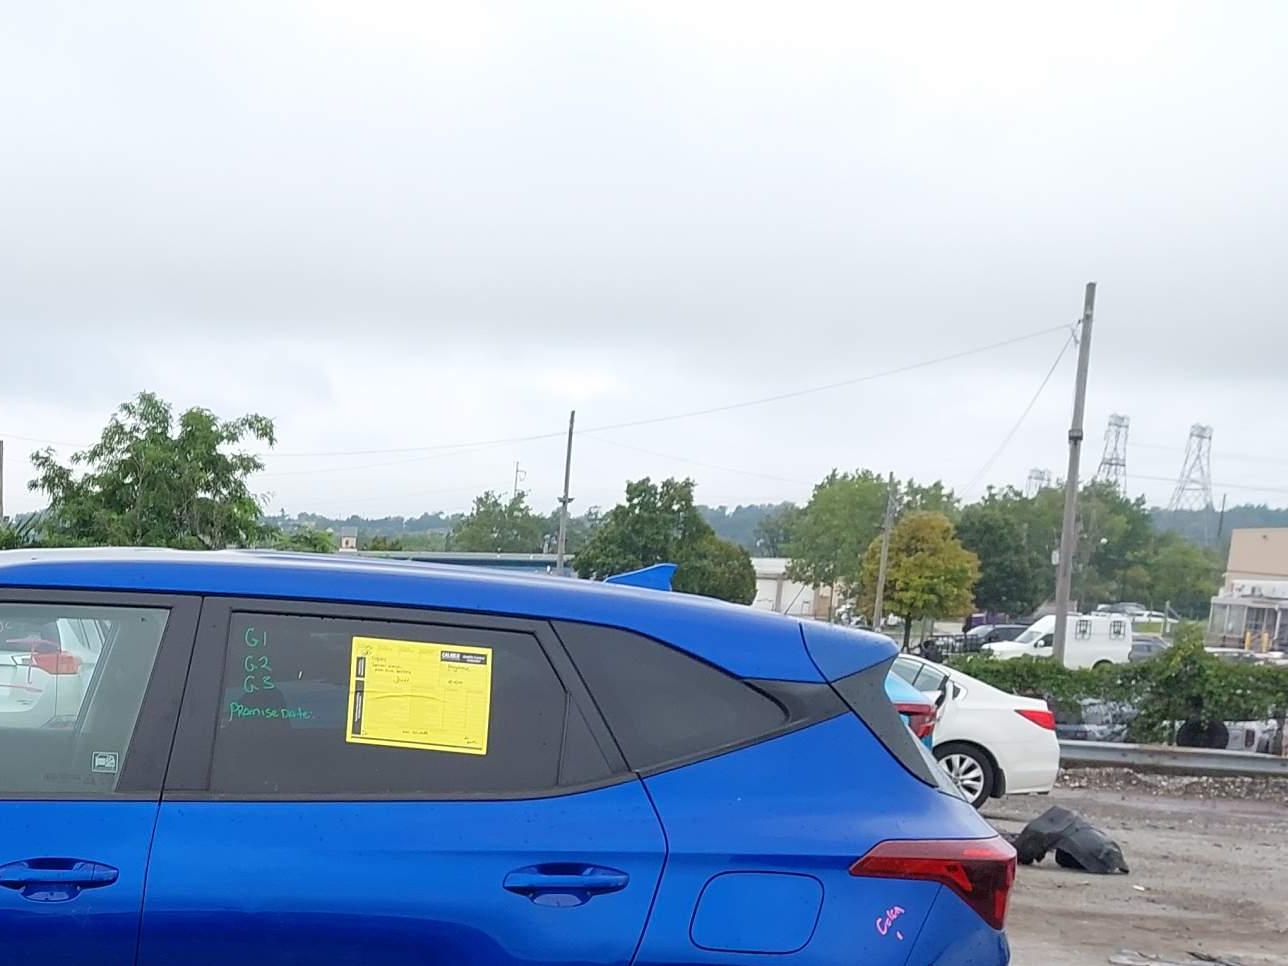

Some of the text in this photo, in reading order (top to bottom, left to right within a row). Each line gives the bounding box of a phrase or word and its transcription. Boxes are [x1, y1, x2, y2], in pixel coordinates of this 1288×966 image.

[244, 627, 267, 647] G1
[244, 655, 272, 672] G2
[243, 675, 275, 693] G3
